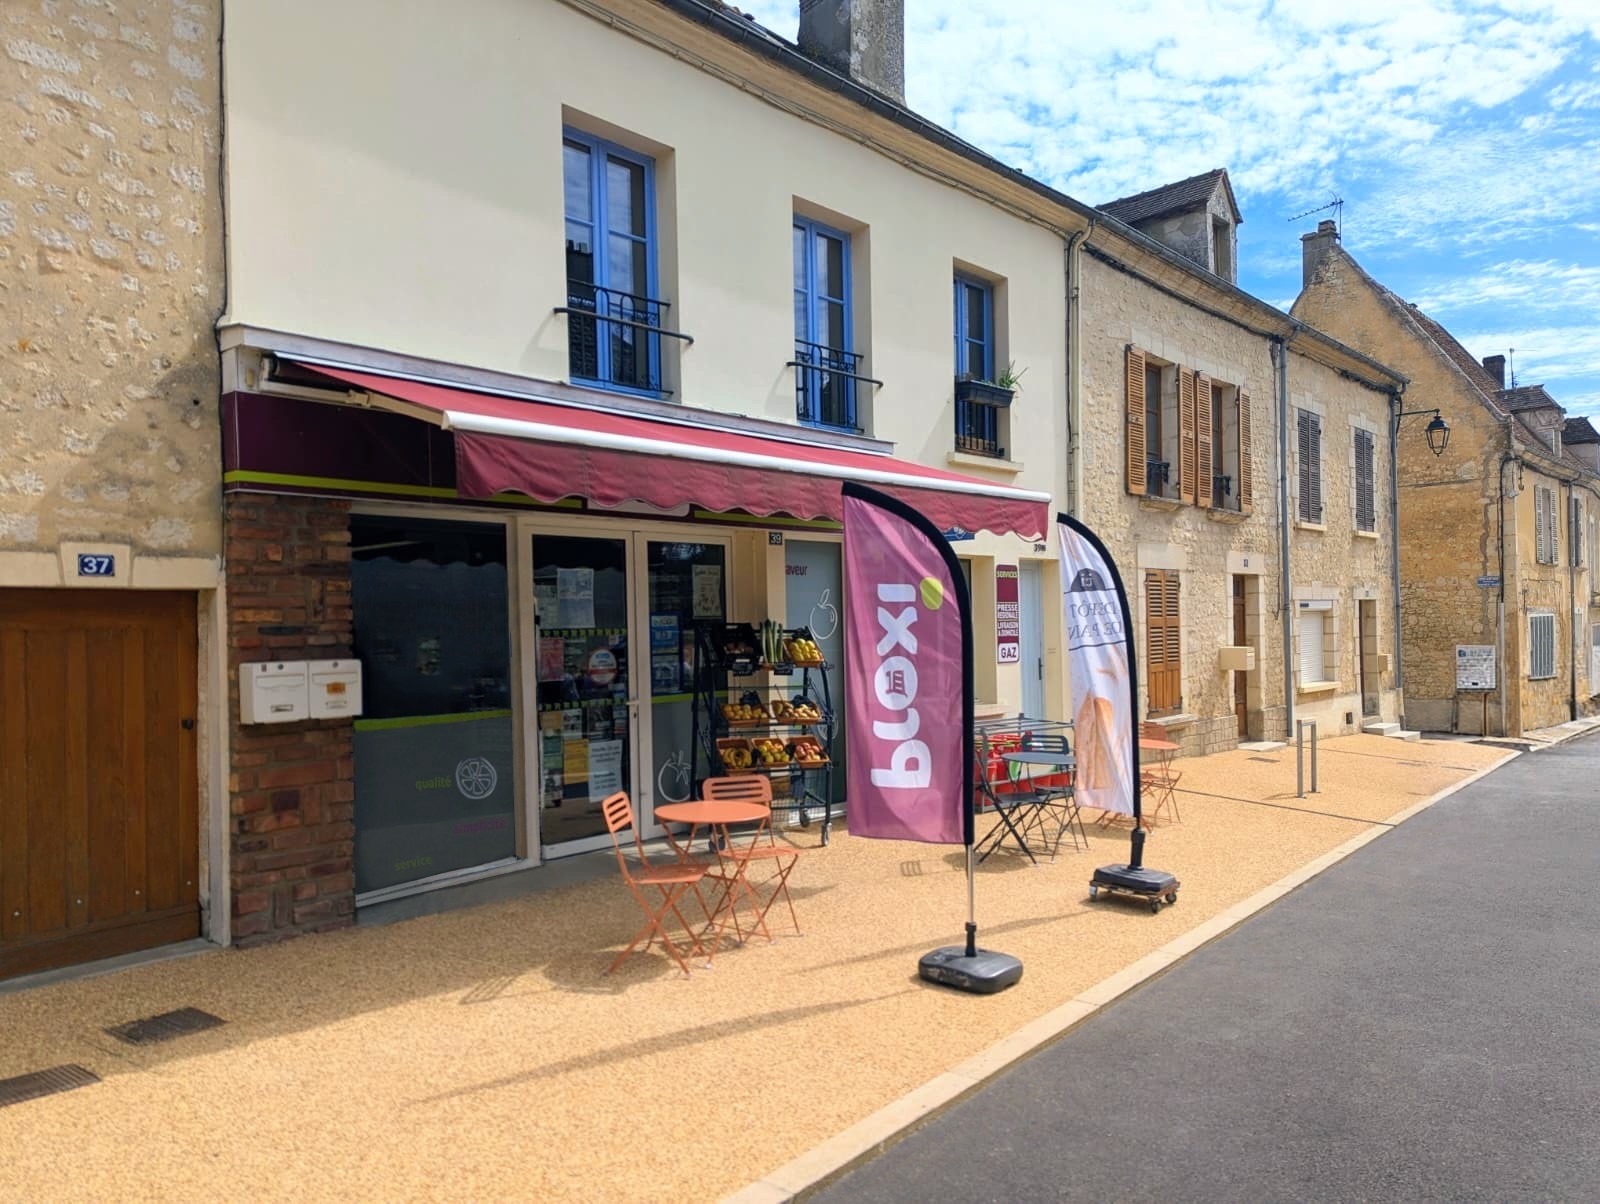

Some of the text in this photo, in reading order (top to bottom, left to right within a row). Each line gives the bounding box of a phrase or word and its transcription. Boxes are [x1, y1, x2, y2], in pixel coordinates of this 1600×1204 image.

[770, 533, 782, 544] 39
[83, 556, 110, 574] 37
[785, 564, 808, 576] aveur
[1000, 646, 1017, 659] GAZ
[415, 775, 453, 791] qualité
[394, 855, 433, 872] service
